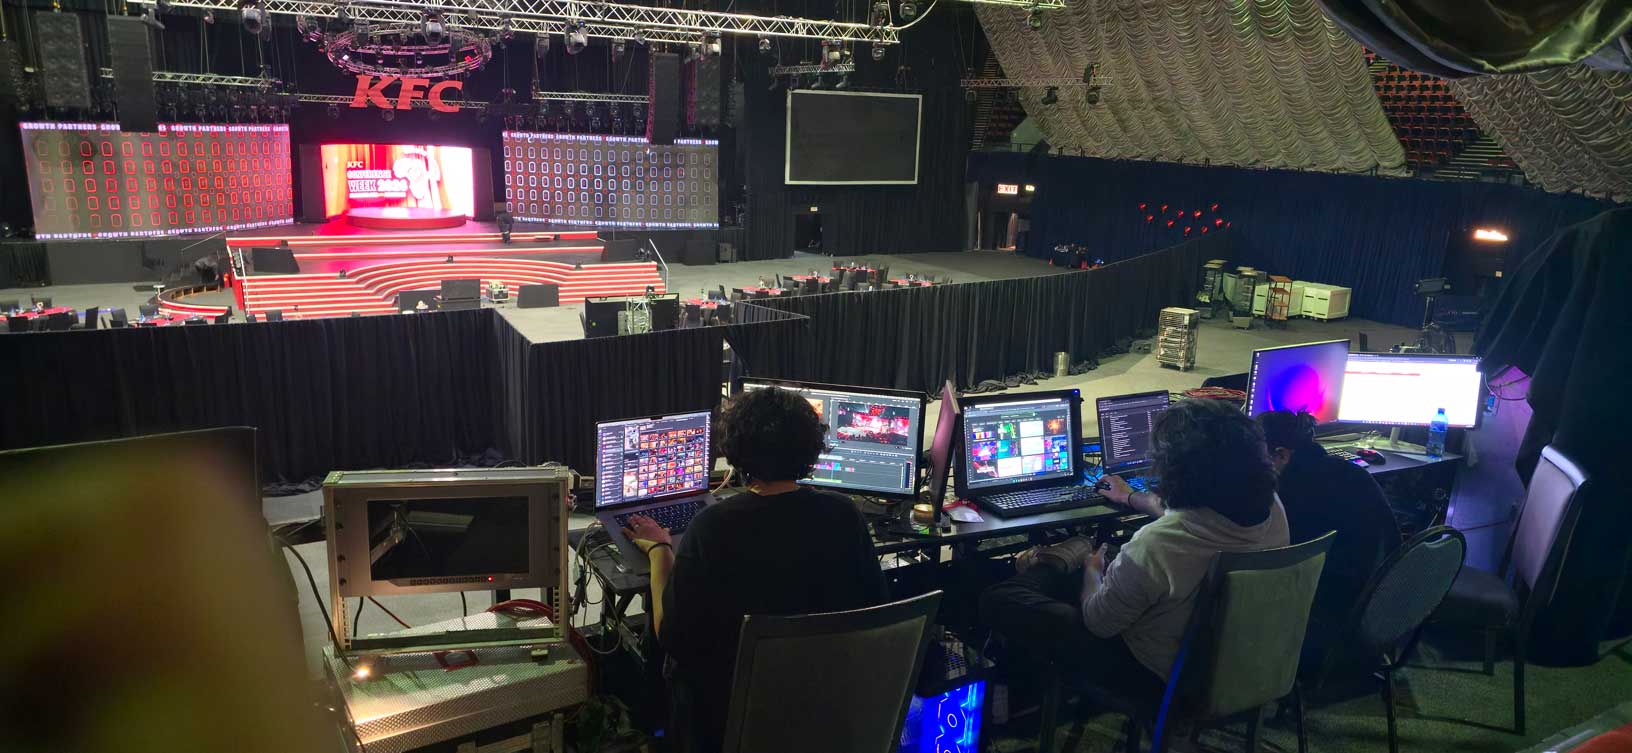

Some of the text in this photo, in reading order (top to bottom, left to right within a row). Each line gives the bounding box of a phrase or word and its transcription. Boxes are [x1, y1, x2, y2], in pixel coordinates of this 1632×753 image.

[349, 74, 463, 113] KFC
[347, 161, 364, 169] KFC
[348, 180, 377, 192] WEEK
[999, 185, 1017, 193] EXIT
